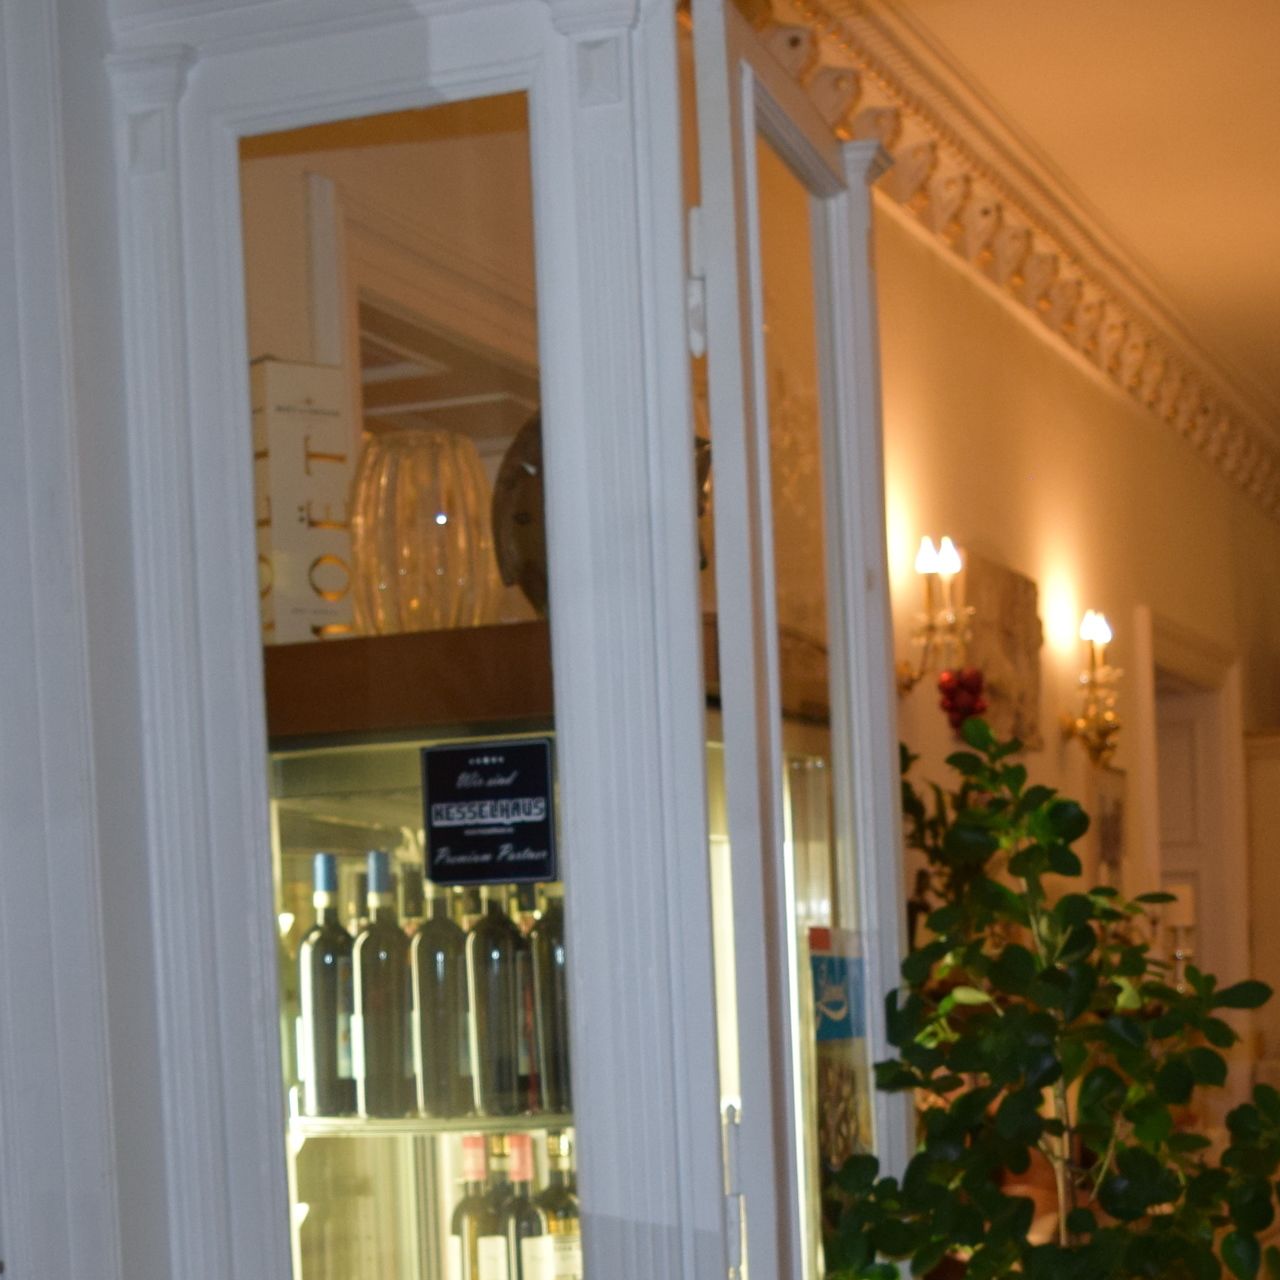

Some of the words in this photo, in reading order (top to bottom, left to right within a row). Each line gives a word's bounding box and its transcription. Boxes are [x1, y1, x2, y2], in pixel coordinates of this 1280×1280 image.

[433, 798, 545, 824] KESSELHAUS
[434, 846, 491, 865] Premium
[496, 843, 548, 861] Partner
